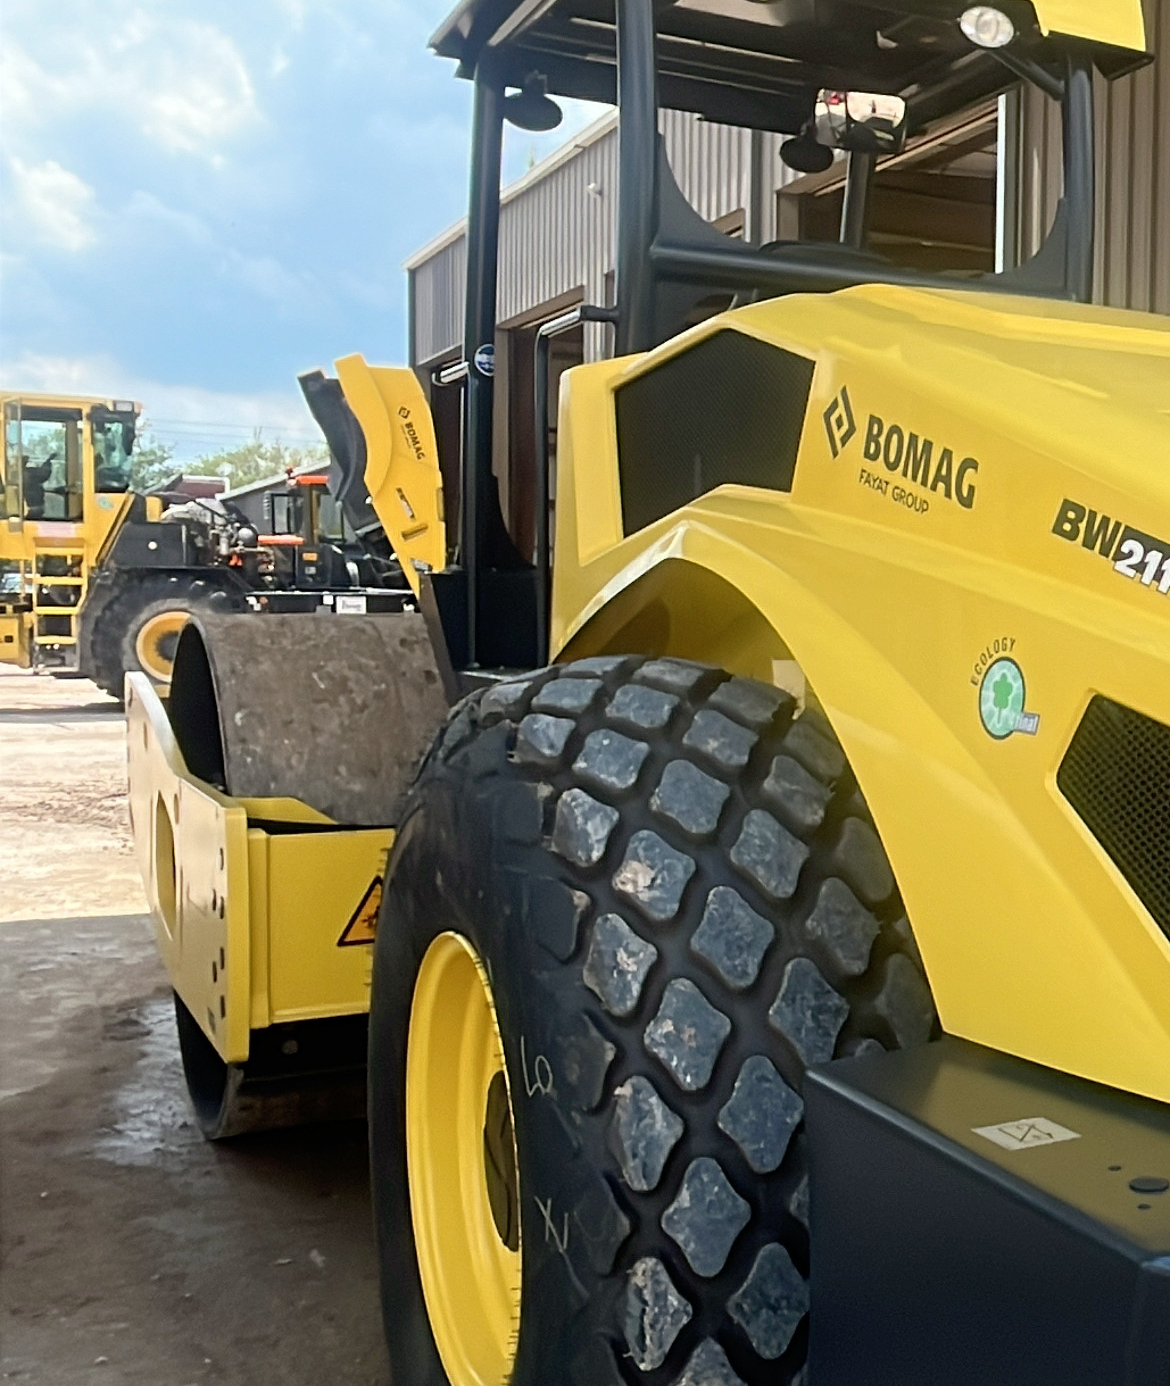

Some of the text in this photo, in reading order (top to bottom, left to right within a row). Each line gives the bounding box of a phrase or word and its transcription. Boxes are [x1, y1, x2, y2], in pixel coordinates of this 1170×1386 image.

[863, 413, 979, 510] BOMAG
[859, 467, 929, 514] FAYAT GROUP
[969, 636, 1016, 686] ECOLOGY
